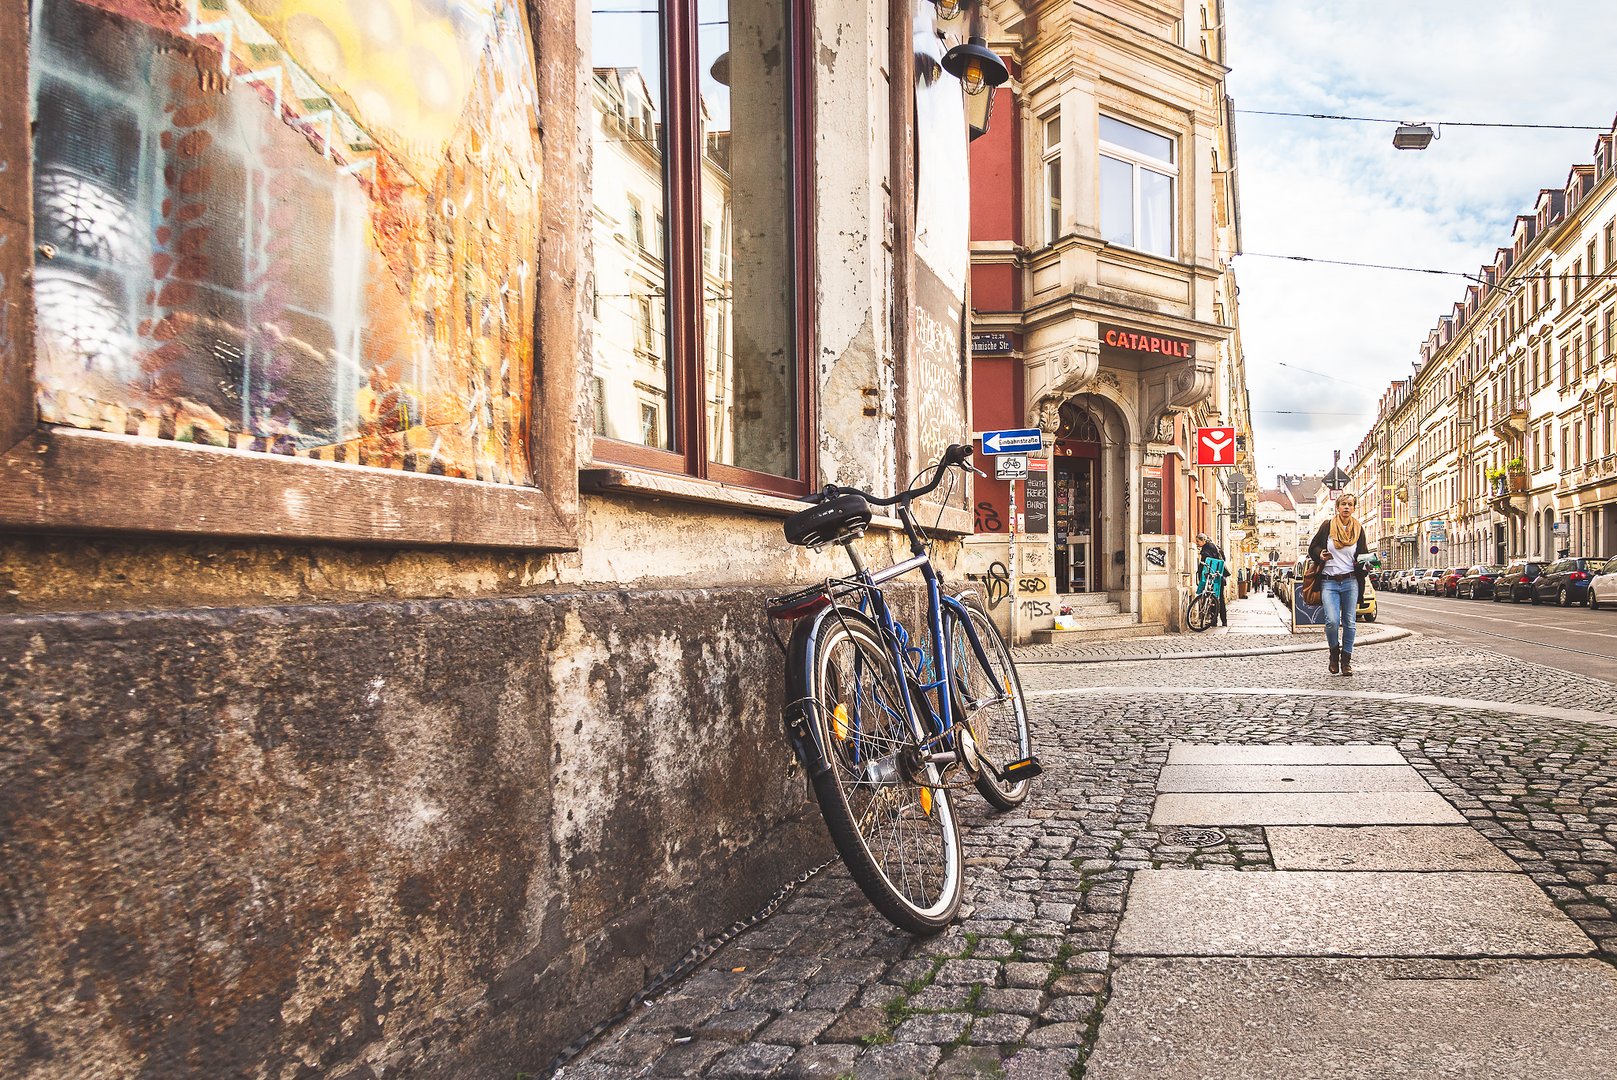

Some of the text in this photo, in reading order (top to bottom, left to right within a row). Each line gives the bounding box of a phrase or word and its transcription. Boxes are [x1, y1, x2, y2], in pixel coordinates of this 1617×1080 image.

[999, 341, 1010, 350] Str.
[1106, 329, 1189, 358] CATAPULT
[999, 437, 1039, 446] Einbahnstraße
[1018, 577, 1047, 593] SGD
[1019, 600, 1054, 620] 1953
